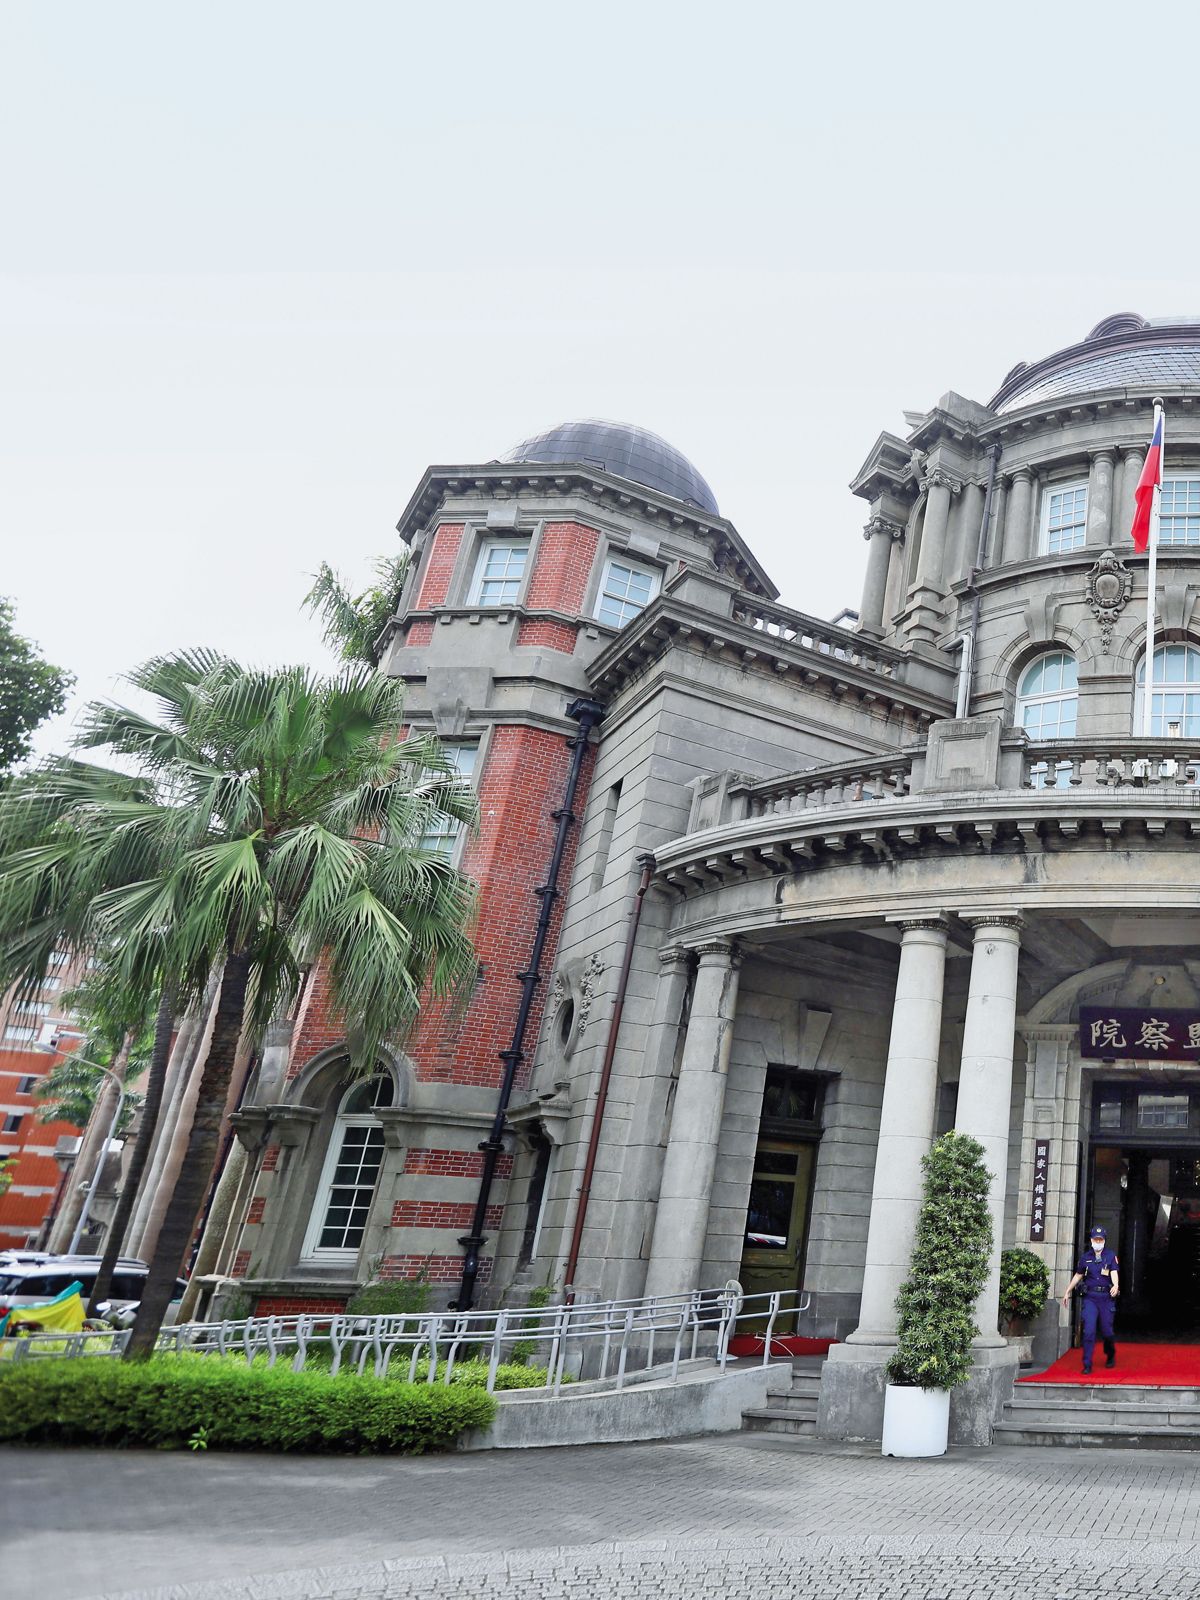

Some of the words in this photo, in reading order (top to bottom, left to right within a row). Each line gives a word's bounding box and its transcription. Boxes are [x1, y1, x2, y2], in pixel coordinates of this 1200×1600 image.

[1031, 1146, 1047, 1233] 國家人權委員會
